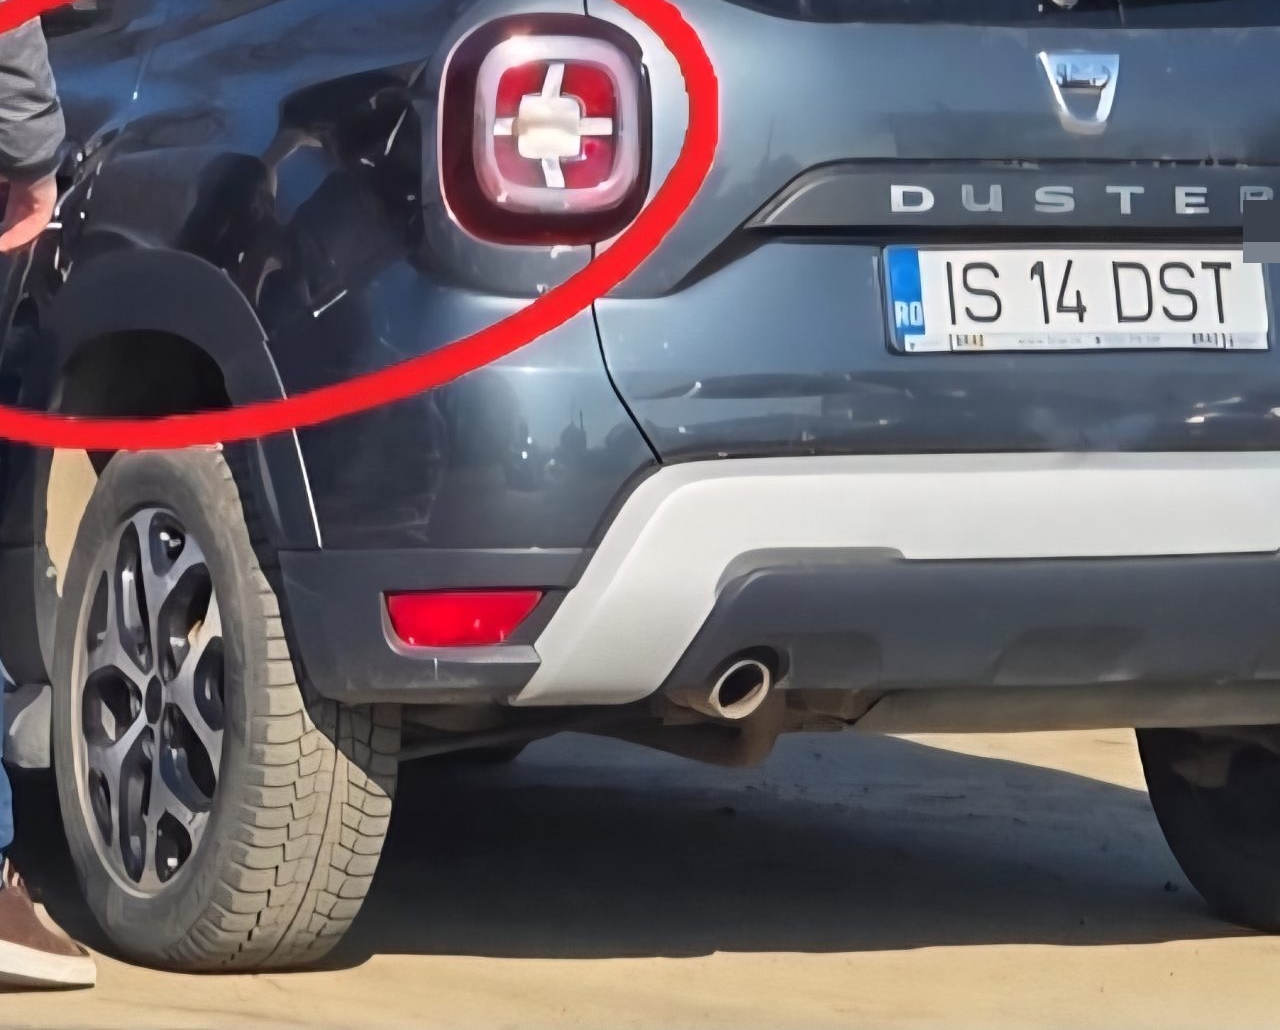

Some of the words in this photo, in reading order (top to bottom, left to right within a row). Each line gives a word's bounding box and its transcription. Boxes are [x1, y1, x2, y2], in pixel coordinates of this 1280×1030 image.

[894, 301, 923, 328] RO
[946, 261, 1002, 325] IS
[1030, 259, 1086, 324] 14
[1112, 260, 1231, 324] DST
